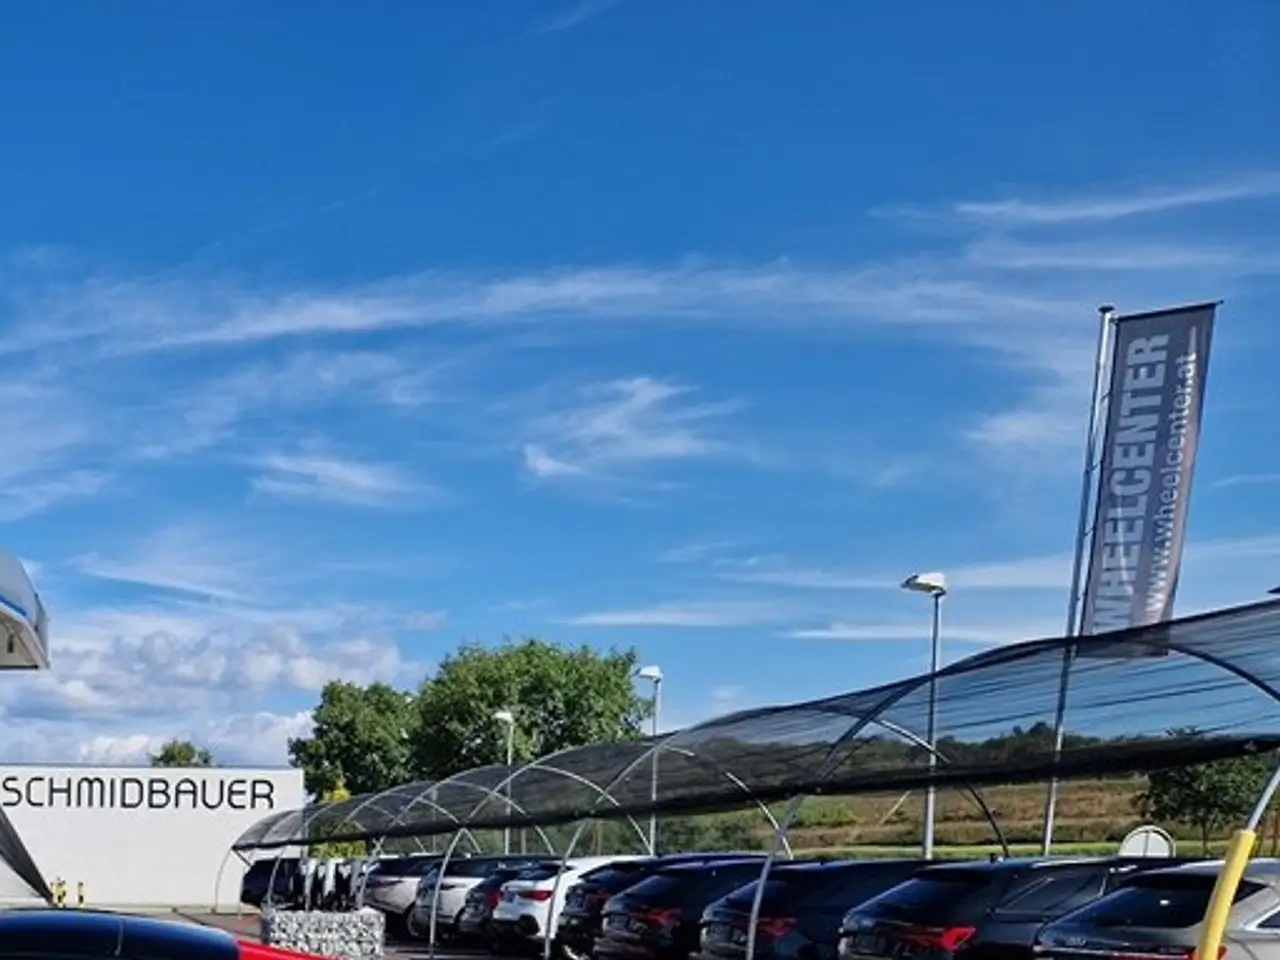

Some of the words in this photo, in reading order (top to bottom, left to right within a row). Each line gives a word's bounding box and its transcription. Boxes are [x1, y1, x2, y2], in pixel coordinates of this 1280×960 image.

[1093, 333, 1169, 635] WHEELCENTER
[1145, 352, 1196, 613] www.wheelcenter.at
[2, 776, 275, 809] SCHMIDBAUER
